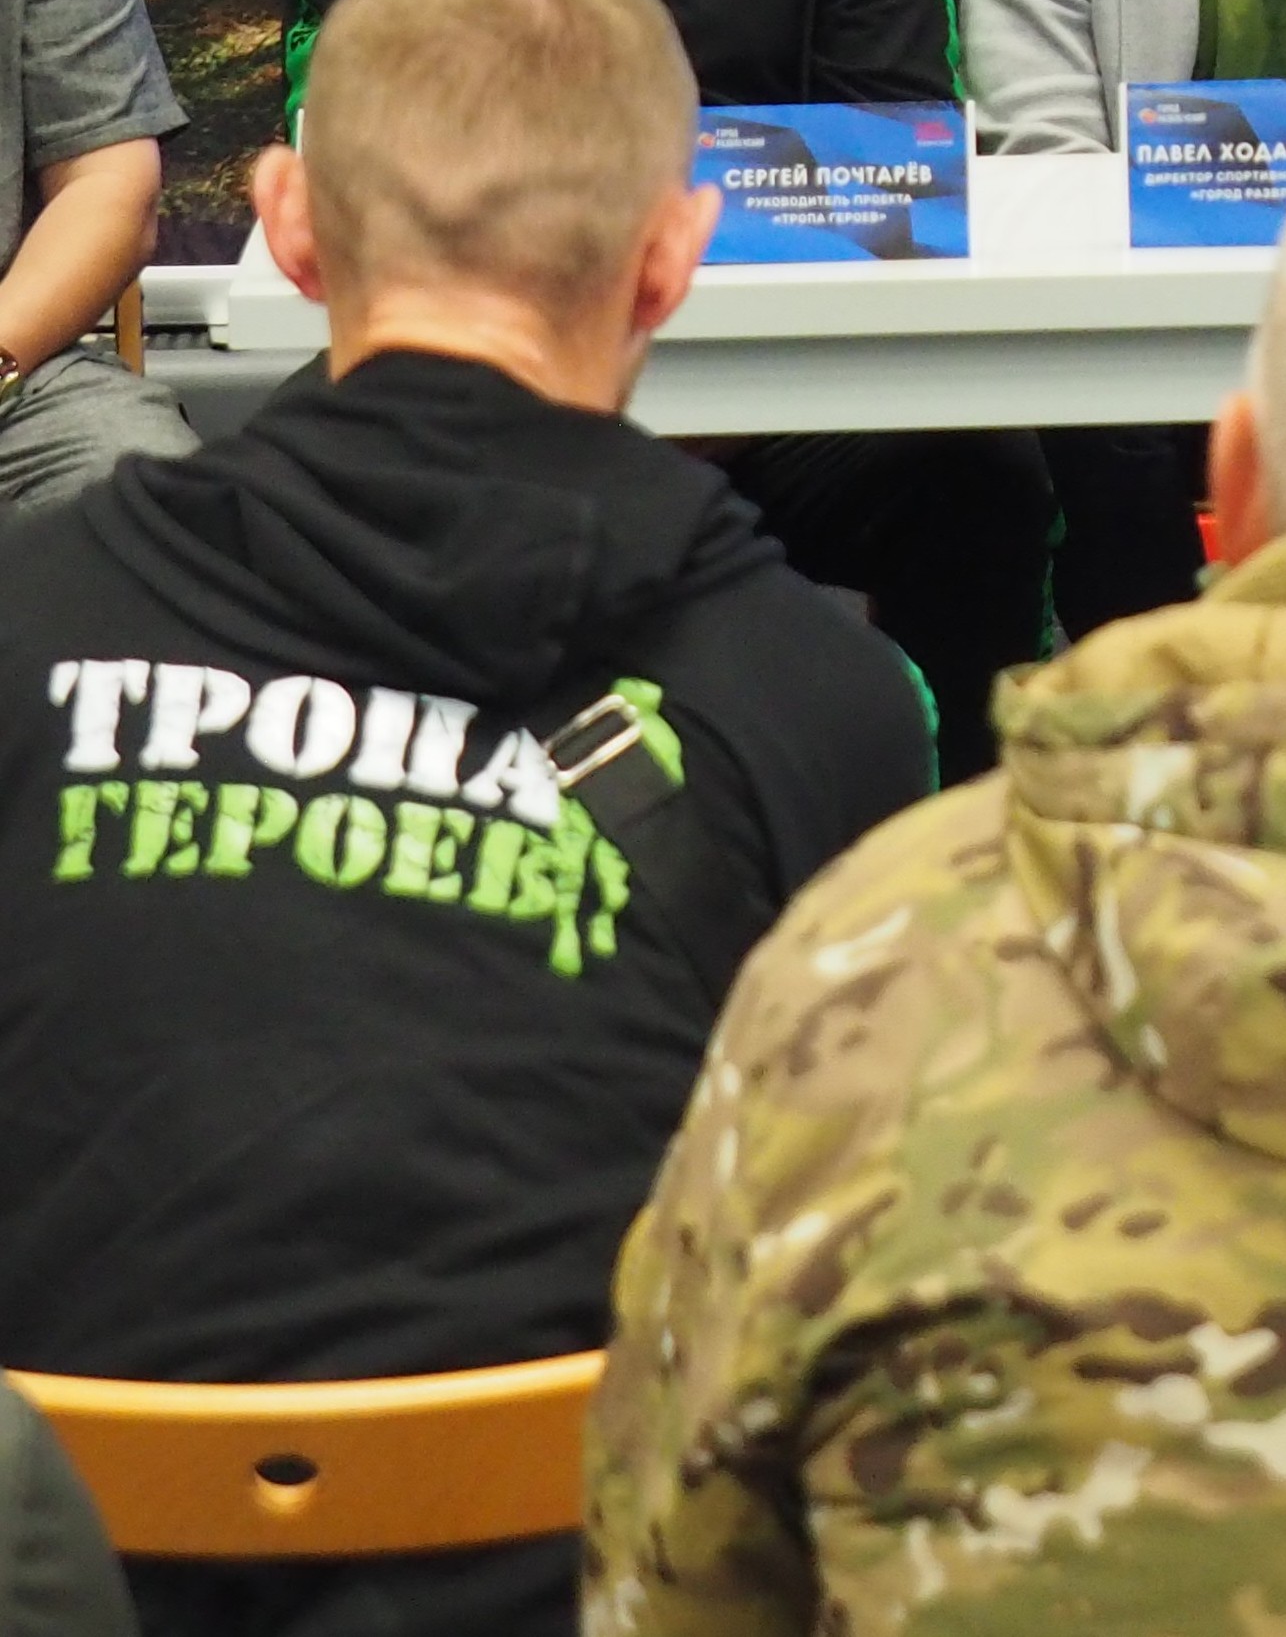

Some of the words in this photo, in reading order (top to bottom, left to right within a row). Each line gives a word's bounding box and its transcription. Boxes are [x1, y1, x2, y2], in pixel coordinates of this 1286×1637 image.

[1137, 143, 1212, 162] ПАВЕЛ
[724, 164, 808, 189] СЕРГЕЙ
[816, 161, 933, 187] ПОЧТАРЁВ
[1145, 171, 1213, 186] ДИРЕКТОР
[747, 194, 850, 208] РУКОВОДИТЕЛЬ
[854, 192, 913, 206] ПРОЕКТА
[772, 212, 825, 226] «ТРОПА
[829, 211, 887, 225] ГЕРОЕВ»
[49, 659, 562, 826] ТРОПА
[52, 779, 558, 923] ГЕРОЕВ
